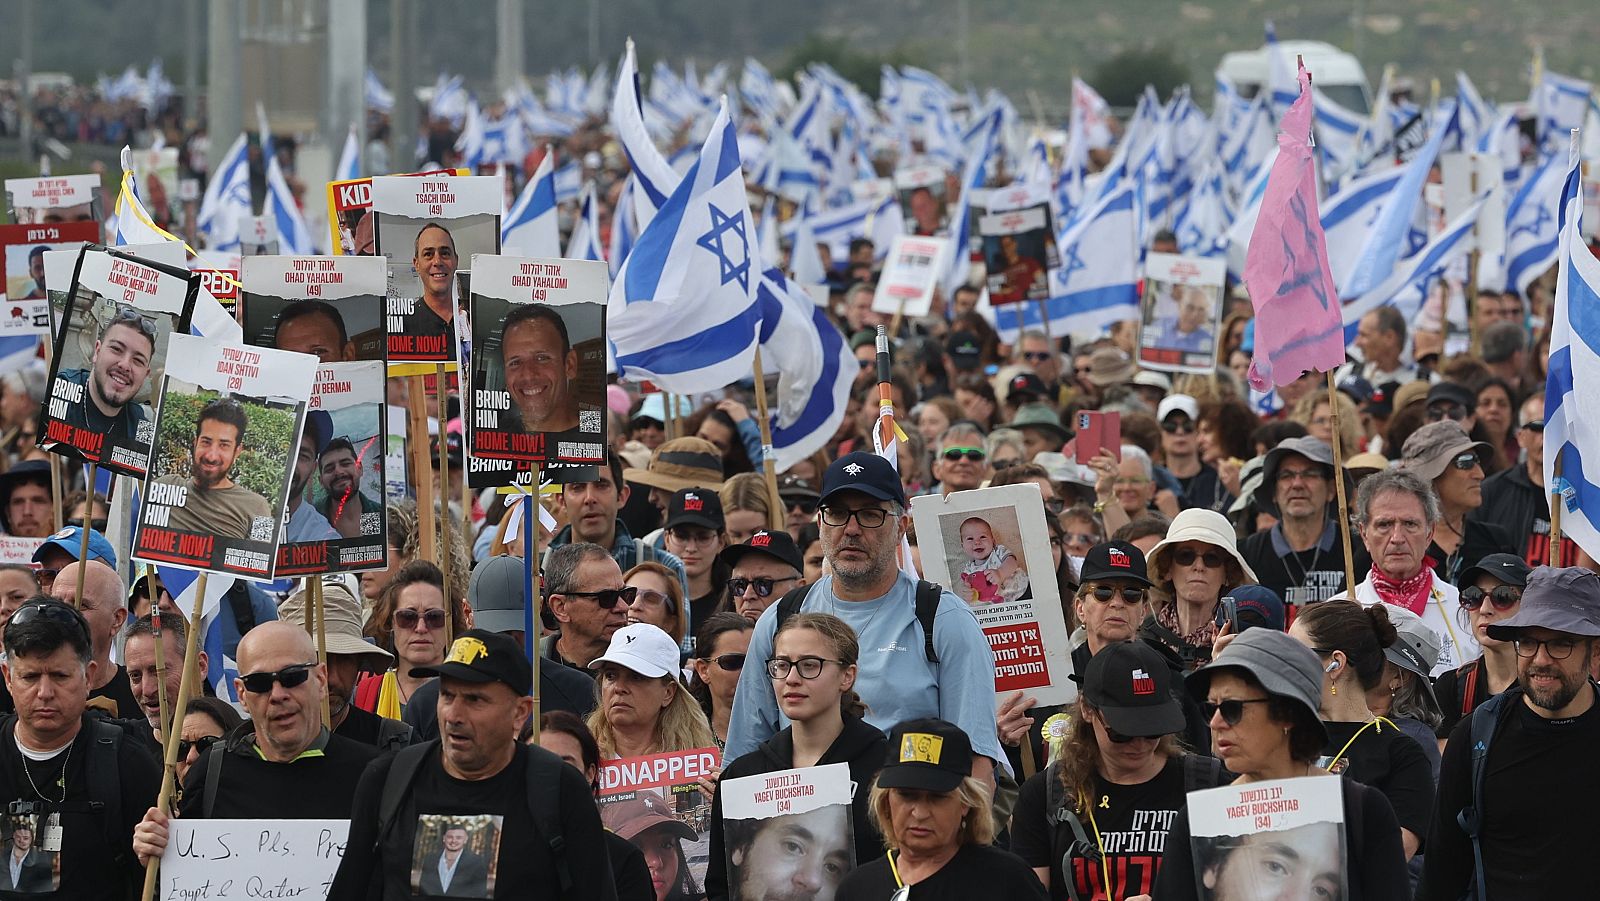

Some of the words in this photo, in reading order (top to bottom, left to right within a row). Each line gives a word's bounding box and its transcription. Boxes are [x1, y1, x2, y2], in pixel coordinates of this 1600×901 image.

[416, 193, 438, 204] TSACHI
[439, 193, 455, 204] IDAN
[428, 204, 442, 216] (49)
[293, 259, 315, 271] יהלומי
[318, 260, 335, 271] אוהד
[520, 264, 542, 275] יהלומי
[544, 264, 561, 276] אוהד
[108, 272, 129, 287] ALMOG
[129, 278, 145, 292] MEIR
[145, 282, 158, 295] JAN
[285, 272, 304, 283] OHAD
[307, 272, 343, 283] YAHALOMI
[512, 276, 531, 287] OHAD
[533, 277, 568, 289] YAHALOMI
[123, 289, 135, 303] (21)
[306, 284, 322, 296] (49)
[532, 289, 547, 301] (49)
[416, 334, 447, 352] NOW!
[217, 361, 234, 374] IDAN
[234, 364, 259, 378] SHTIVI
[52, 377, 83, 404] BRING
[227, 376, 242, 391] (28)
[322, 381, 351, 394] BERMAN
[308, 396, 321, 408] 26)
[475, 390, 510, 410] BRING
[48, 397, 69, 420] HIM
[475, 410, 498, 428] HIM
[73, 429, 104, 454] NOW!
[476, 431, 508, 450] HOME
[512, 432, 544, 453] NOW!
[111, 452, 132, 466] FAMILIES
[558, 448, 582, 458] FAMILIES
[583, 449, 602, 459] FORUM
[516, 471, 544, 484] NO!
[148, 482, 188, 508] BRING
[684, 500, 704, 509] NOW
[144, 504, 170, 527] HIM
[140, 528, 177, 552] HOME
[178, 534, 214, 558] NOW!
[751, 535, 771, 545] NOW
[292, 540, 328, 565] NOW!
[340, 553, 364, 563] FAMILIES
[364, 550, 383, 561] FORUM
[1110, 555, 1130, 564] NOW
[224, 555, 248, 568] FAMILIES
[248, 558, 269, 571] FORUM
[988, 631, 1018, 645] ניצחו
[1020, 629, 1037, 643] אין
[992, 648, 1019, 661] החזר
[1021, 645, 1041, 657] בלי
[996, 661, 1044, 678] החטופים
[1134, 678, 1155, 691] NOW
[754, 791, 774, 804] YAGEV
[775, 785, 814, 800] BUCHSHTAB
[777, 800, 791, 813] (34)
[1226, 804, 1250, 819] YAGEV
[1252, 799, 1299, 815] BUCHSHTAB
[1255, 815, 1271, 829] (34)
[258, 830, 295, 857] Pls.
[317, 829, 348, 859] Pre
[168, 877, 214, 901] Egypt
[246, 876, 310, 898] Qatar
